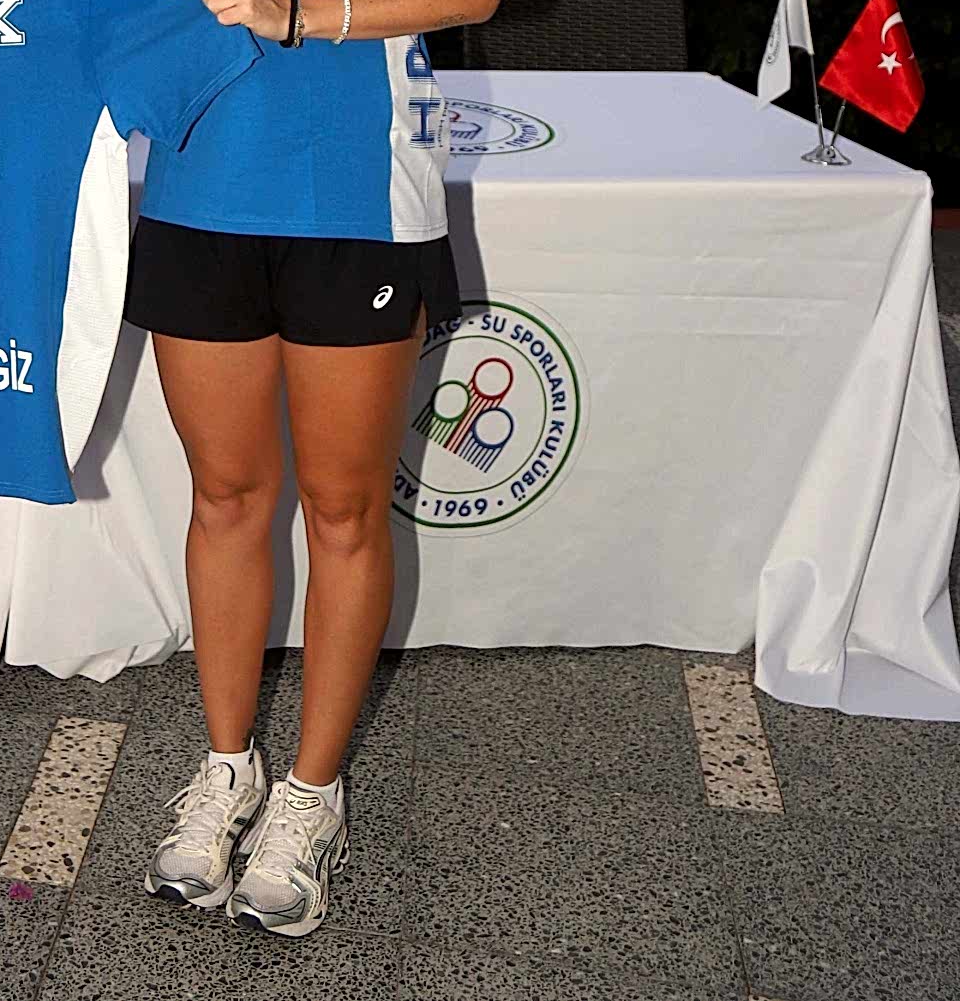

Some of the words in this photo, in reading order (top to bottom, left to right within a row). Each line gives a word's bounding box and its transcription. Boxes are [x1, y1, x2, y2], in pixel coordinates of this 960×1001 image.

[481, 314, 507, 333] SU
[510, 324, 567, 411] SPORLARI
[510, 419, 566, 502] KULÜBÜ
[433, 497, 488, 517] 1969
